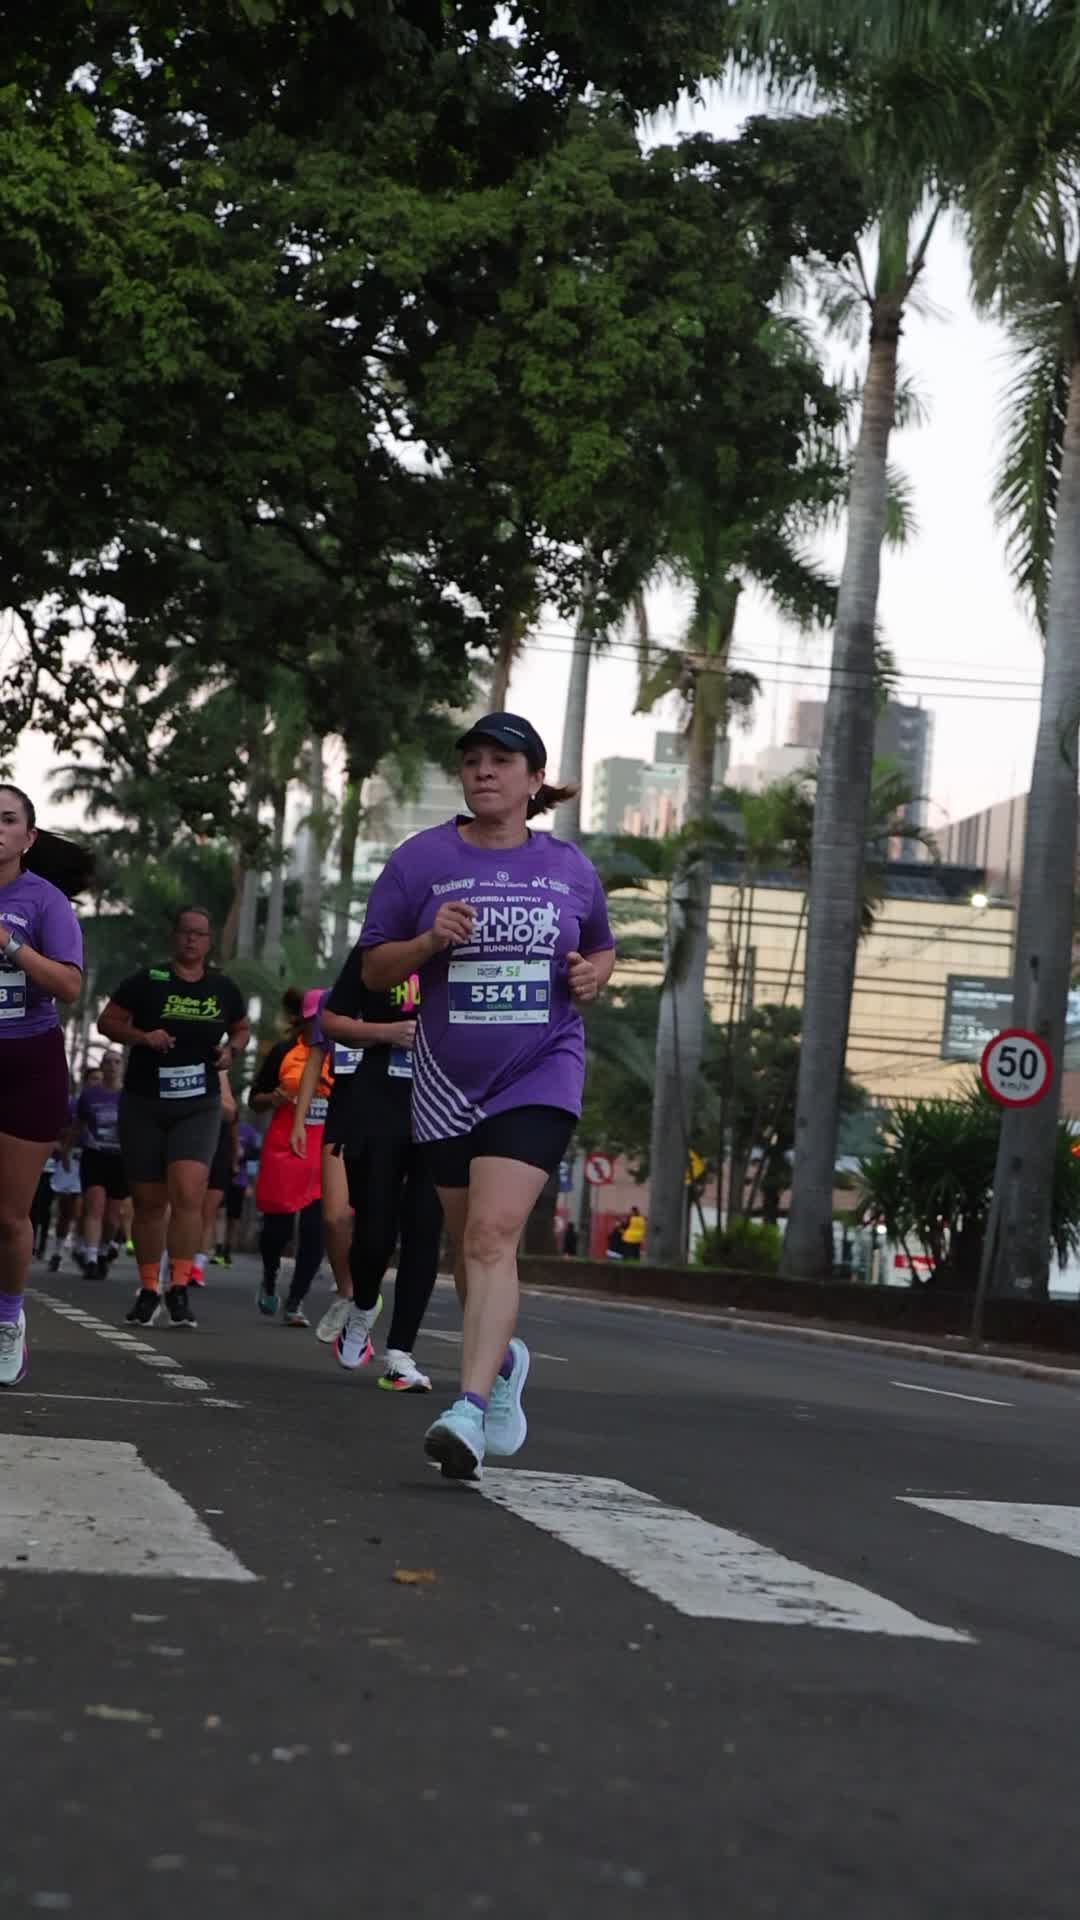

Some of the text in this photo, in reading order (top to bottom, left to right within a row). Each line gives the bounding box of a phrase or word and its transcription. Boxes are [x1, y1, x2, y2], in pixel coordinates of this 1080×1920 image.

[432, 878, 474, 896] Bestway
[470, 895, 505, 903] CORRIDA
[506, 895, 542, 903] BESTWAY
[464, 924, 546, 944] ELHOR
[483, 945, 524, 953] RUNNING
[168, 995, 201, 1006] Clube
[472, 984, 527, 1003] 5541
[997, 1045, 1038, 1080] 50
[170, 1076, 197, 1088] 5614
